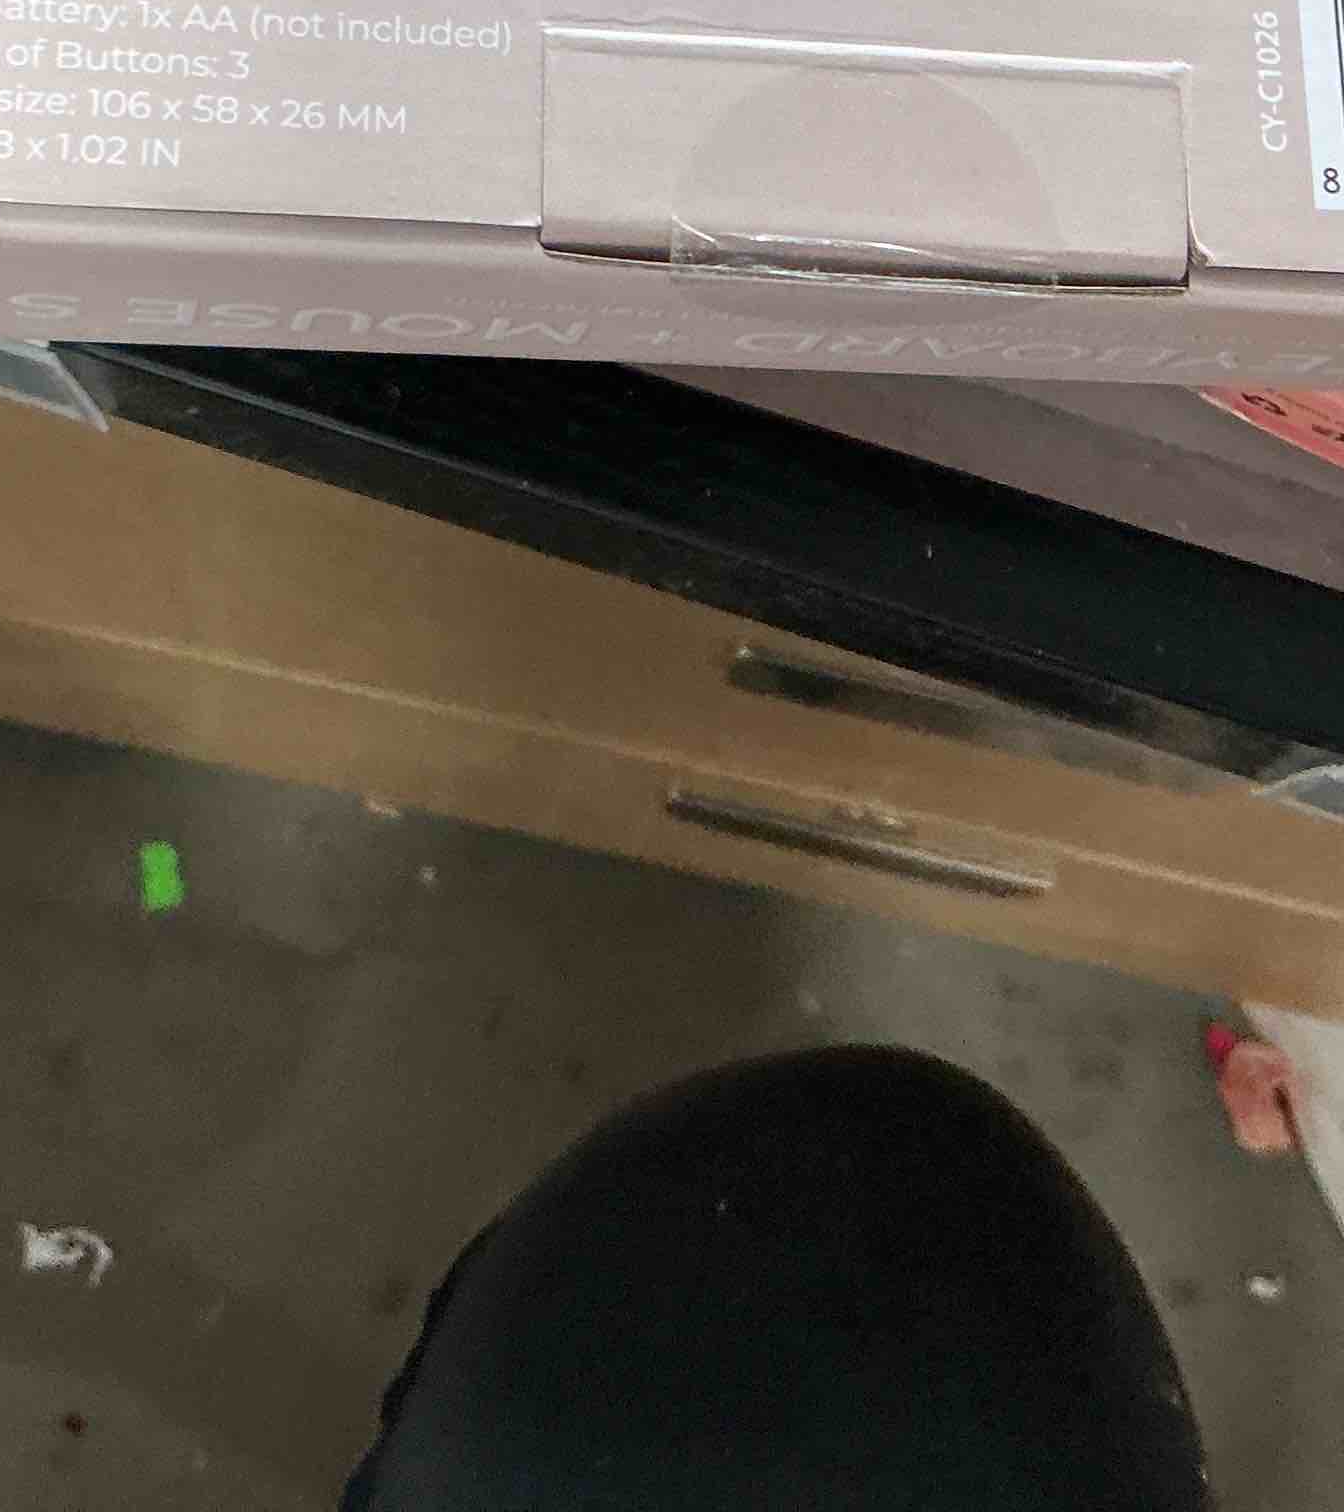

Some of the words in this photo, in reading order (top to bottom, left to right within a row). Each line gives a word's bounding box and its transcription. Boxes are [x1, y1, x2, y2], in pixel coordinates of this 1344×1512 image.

[181, 2, 238, 36] AA
[249, 3, 326, 42] (not
[336, 10, 514, 56] included)
[5, 35, 47, 70] of
[57, 40, 220, 80] Buttons:
[1253, 9, 1287, 153] CY-C1026
[87, 88, 152, 122] 106
[192, 93, 240, 125] 58
[279, 98, 326, 131] 26
[337, 101, 409, 135] MM
[59, 132, 129, 166] 1.02
[139, 137, 181, 169] IN
[126, 295, 592, 348] MOUSE
